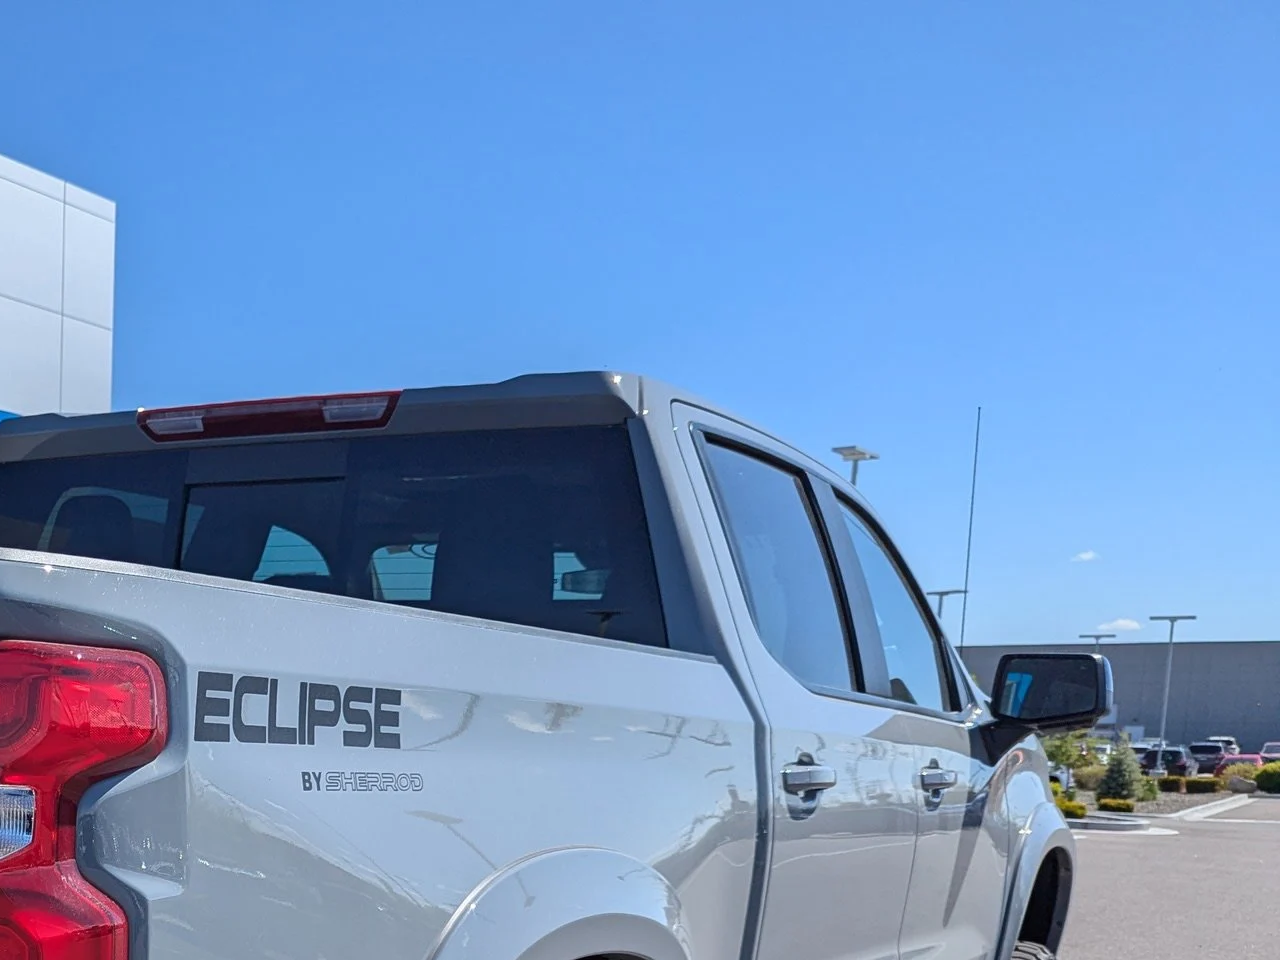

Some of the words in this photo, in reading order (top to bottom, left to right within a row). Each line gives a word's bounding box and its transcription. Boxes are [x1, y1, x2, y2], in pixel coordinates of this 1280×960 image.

[193, 670, 402, 749] ECLIPSE
[301, 771, 322, 791] BY
[325, 771, 424, 791] SHERROD
